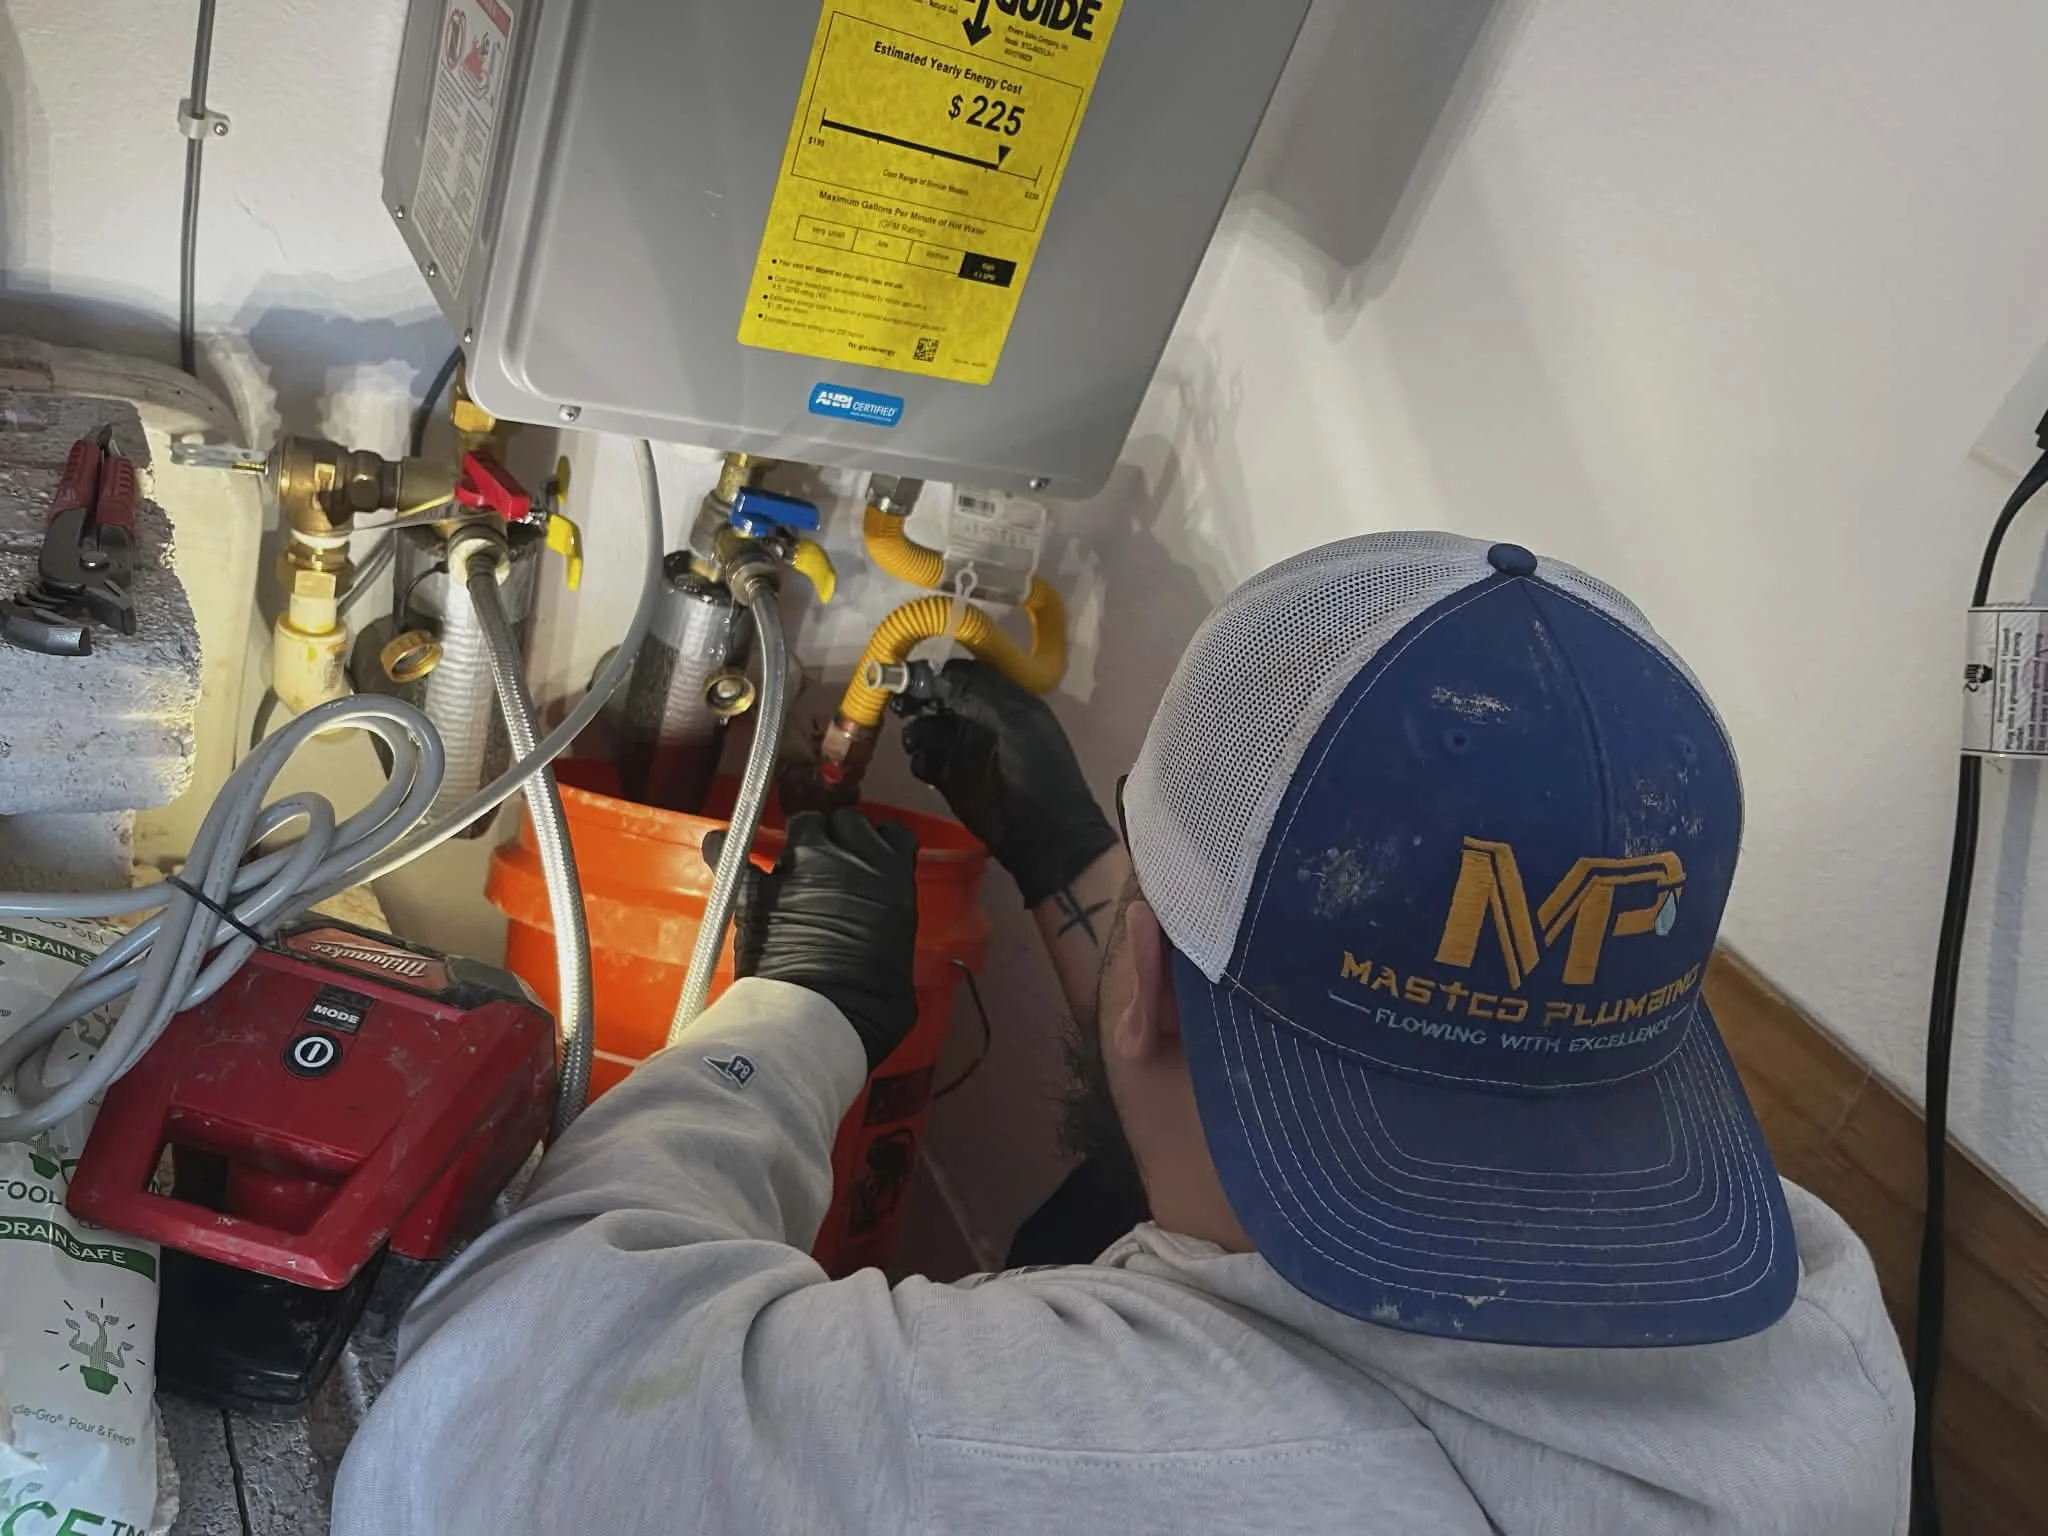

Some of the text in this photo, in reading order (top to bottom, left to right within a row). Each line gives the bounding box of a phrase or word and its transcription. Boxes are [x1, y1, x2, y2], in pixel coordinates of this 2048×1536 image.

[874, 41, 1023, 96] Estimated Yearly Energy Cost
[947, 94, 1026, 137] $ 225
[818, 190, 860, 208] Maximum
[860, 199, 893, 217] Gallons
[894, 207, 909, 219] Per
[910, 211, 937, 226] Minute
[937, 216, 949, 228] of
[852, 400, 898, 417] CERTIFIED
[1432, 835, 1687, 992] MP
[11, 932, 77, 960] DRAIN
[309, 942, 429, 979] Milwaukee
[1340, 950, 1701, 1028] MASTCO PLUMBING
[313, 1003, 361, 1025] MODE
[1374, 1007, 1673, 1053] FLOWING WITH EXCELLENCE
[69, 1241, 127, 1264] SAFE
[68, 1416, 96, 1433] Pour
